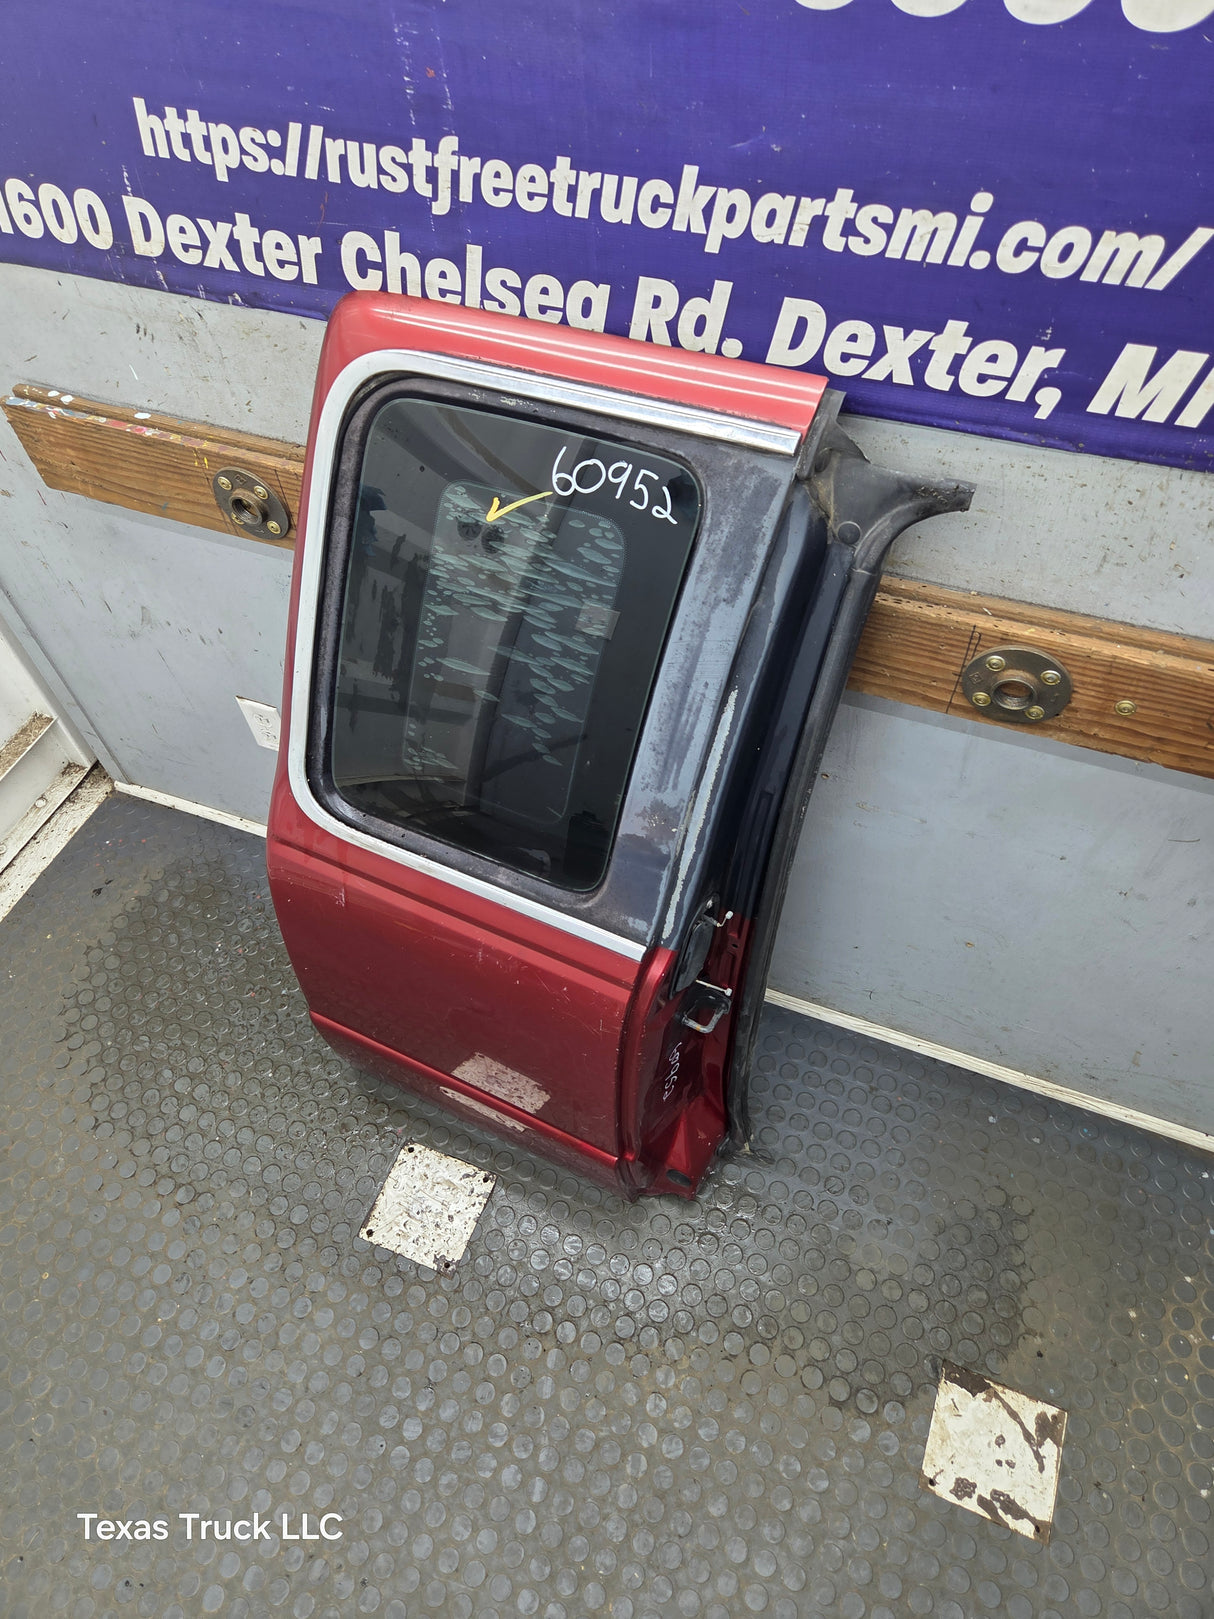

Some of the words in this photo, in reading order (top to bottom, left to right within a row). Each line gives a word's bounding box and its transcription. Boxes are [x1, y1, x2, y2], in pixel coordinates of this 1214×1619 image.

[133, 97, 1214, 291] https://rustfreetruckpartsmi.com/
[121, 194, 322, 285] Dexter
[340, 230, 611, 333] Chelsea
[629, 275, 744, 359] Rd.
[765, 296, 1067, 419] Dexter,
[552, 446, 678, 525] 60952
